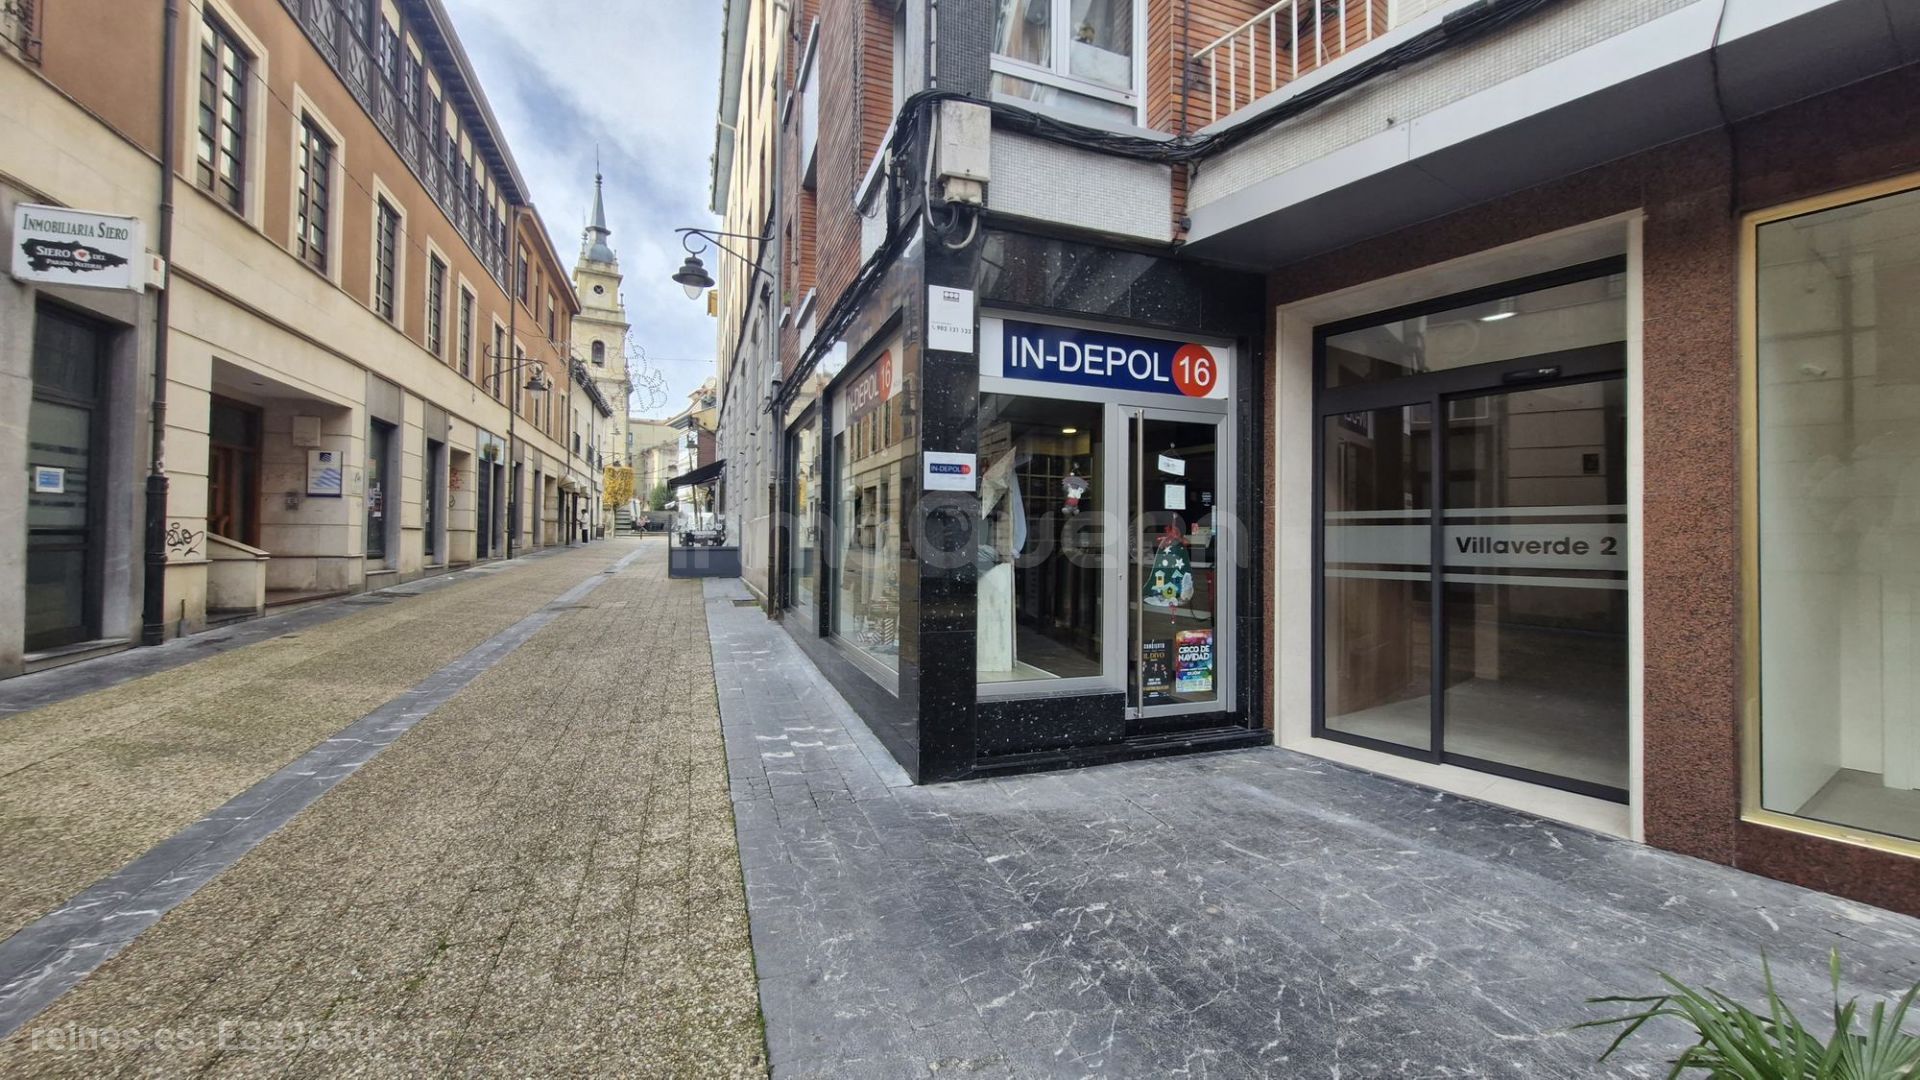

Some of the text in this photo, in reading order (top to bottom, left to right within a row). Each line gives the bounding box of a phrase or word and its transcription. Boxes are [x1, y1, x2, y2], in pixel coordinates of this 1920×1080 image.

[23, 213, 129, 241] INMOBILIARIA SIERO
[36, 245, 71, 258] SIERO
[1011, 336, 1211, 387] IN-DEPOL 16
[881, 360, 891, 392] 16
[931, 464, 961, 473] IN-DEPOL
[1455, 536, 1618, 556] Villaverde 2
[1179, 653, 1209, 661] NAVIDAD
[1201, 645, 1210, 653] DE
